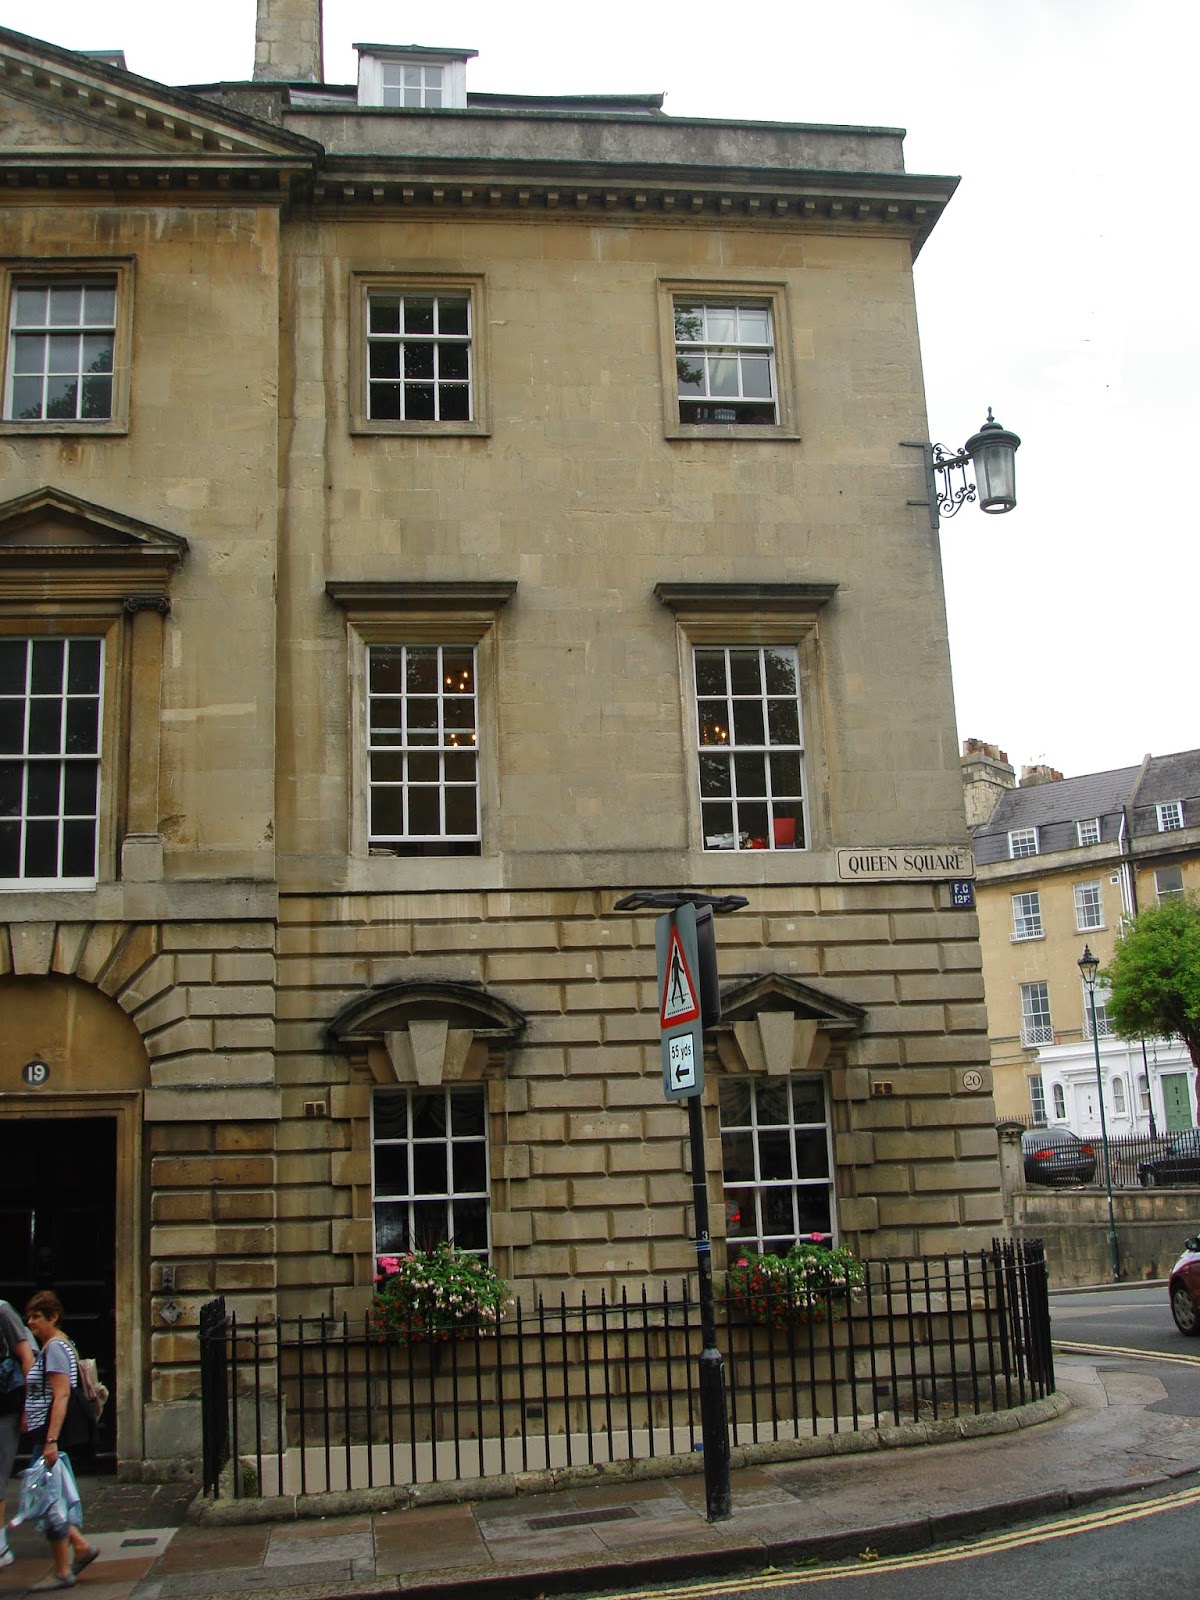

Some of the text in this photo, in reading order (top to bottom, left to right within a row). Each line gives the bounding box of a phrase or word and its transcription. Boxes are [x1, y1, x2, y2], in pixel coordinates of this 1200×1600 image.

[848, 854, 964, 874] QUEEN SQUARE
[671, 1043, 692, 1061] 55 yds
[28, 1064, 46, 1081] 19
[965, 1074, 981, 1086] 20
